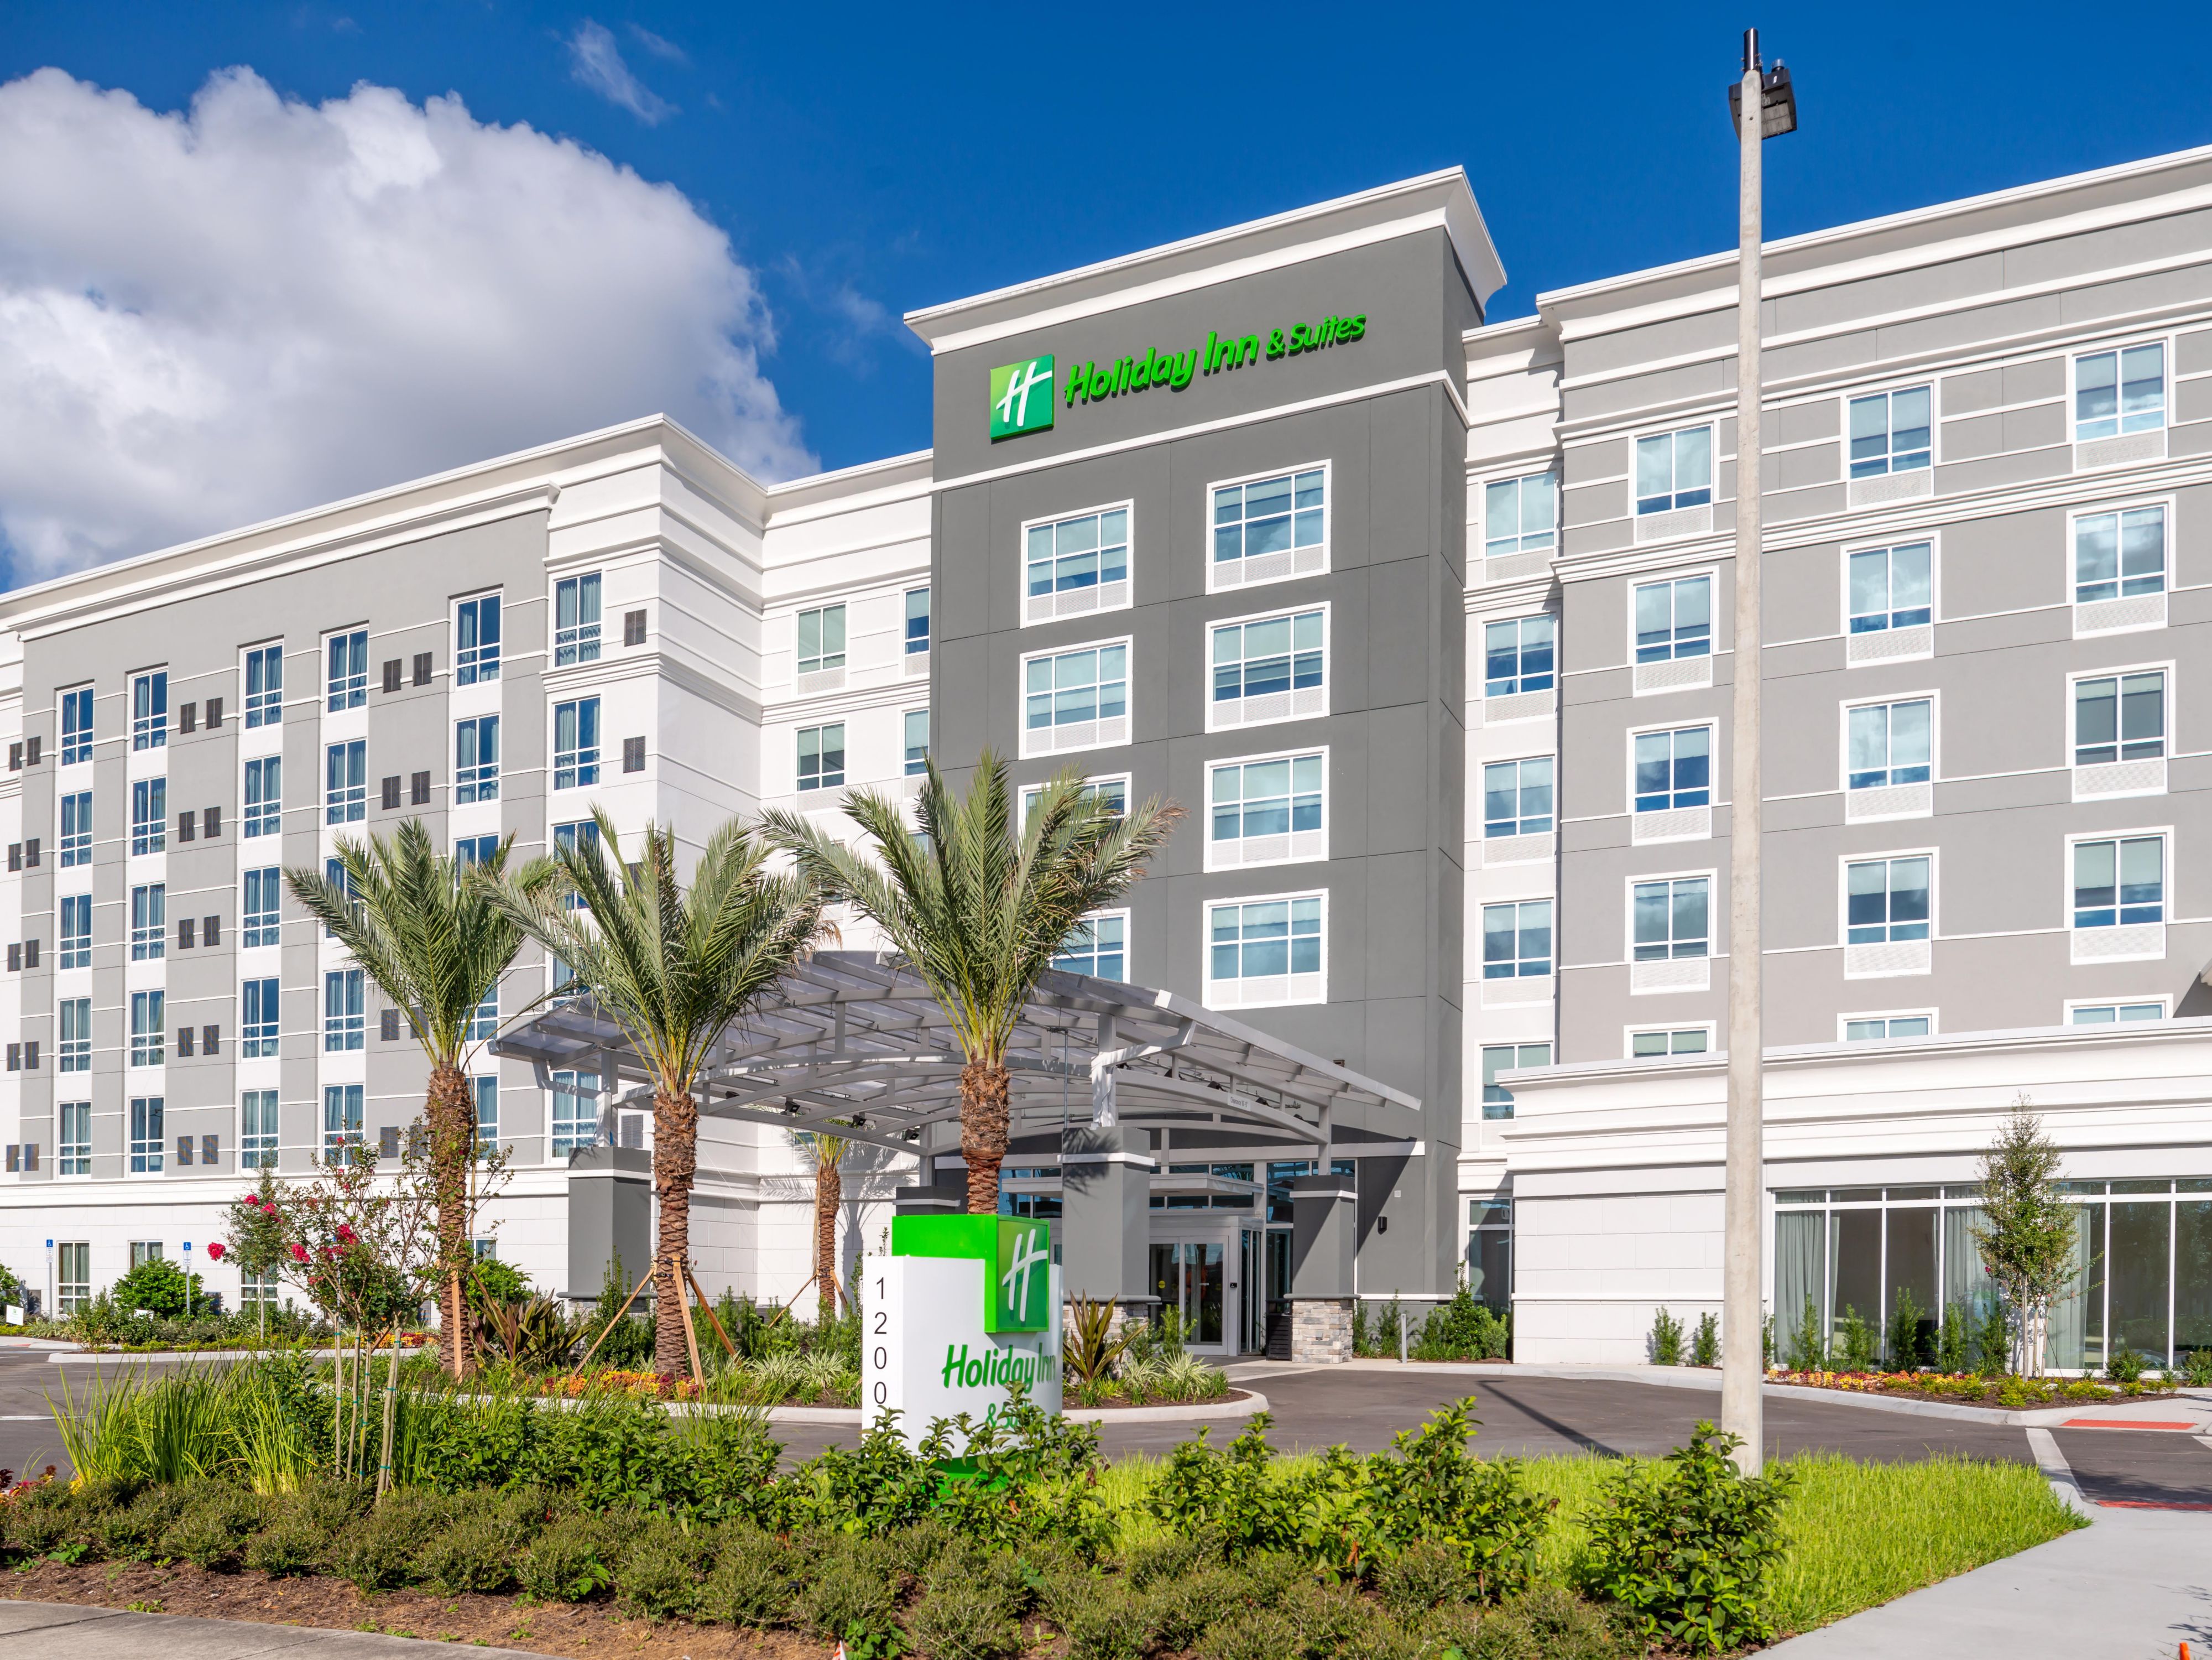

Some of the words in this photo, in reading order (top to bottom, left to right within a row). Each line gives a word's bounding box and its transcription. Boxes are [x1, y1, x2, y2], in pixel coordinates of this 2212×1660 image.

[1063, 347, 1198, 405] Holiday
[1203, 331, 1259, 372] Inn
[1265, 329, 1286, 357] &
[1288, 314, 1367, 353] Suites
[941, 1344, 1035, 1394] Holiday
[1036, 1342, 1056, 1383] Inn
